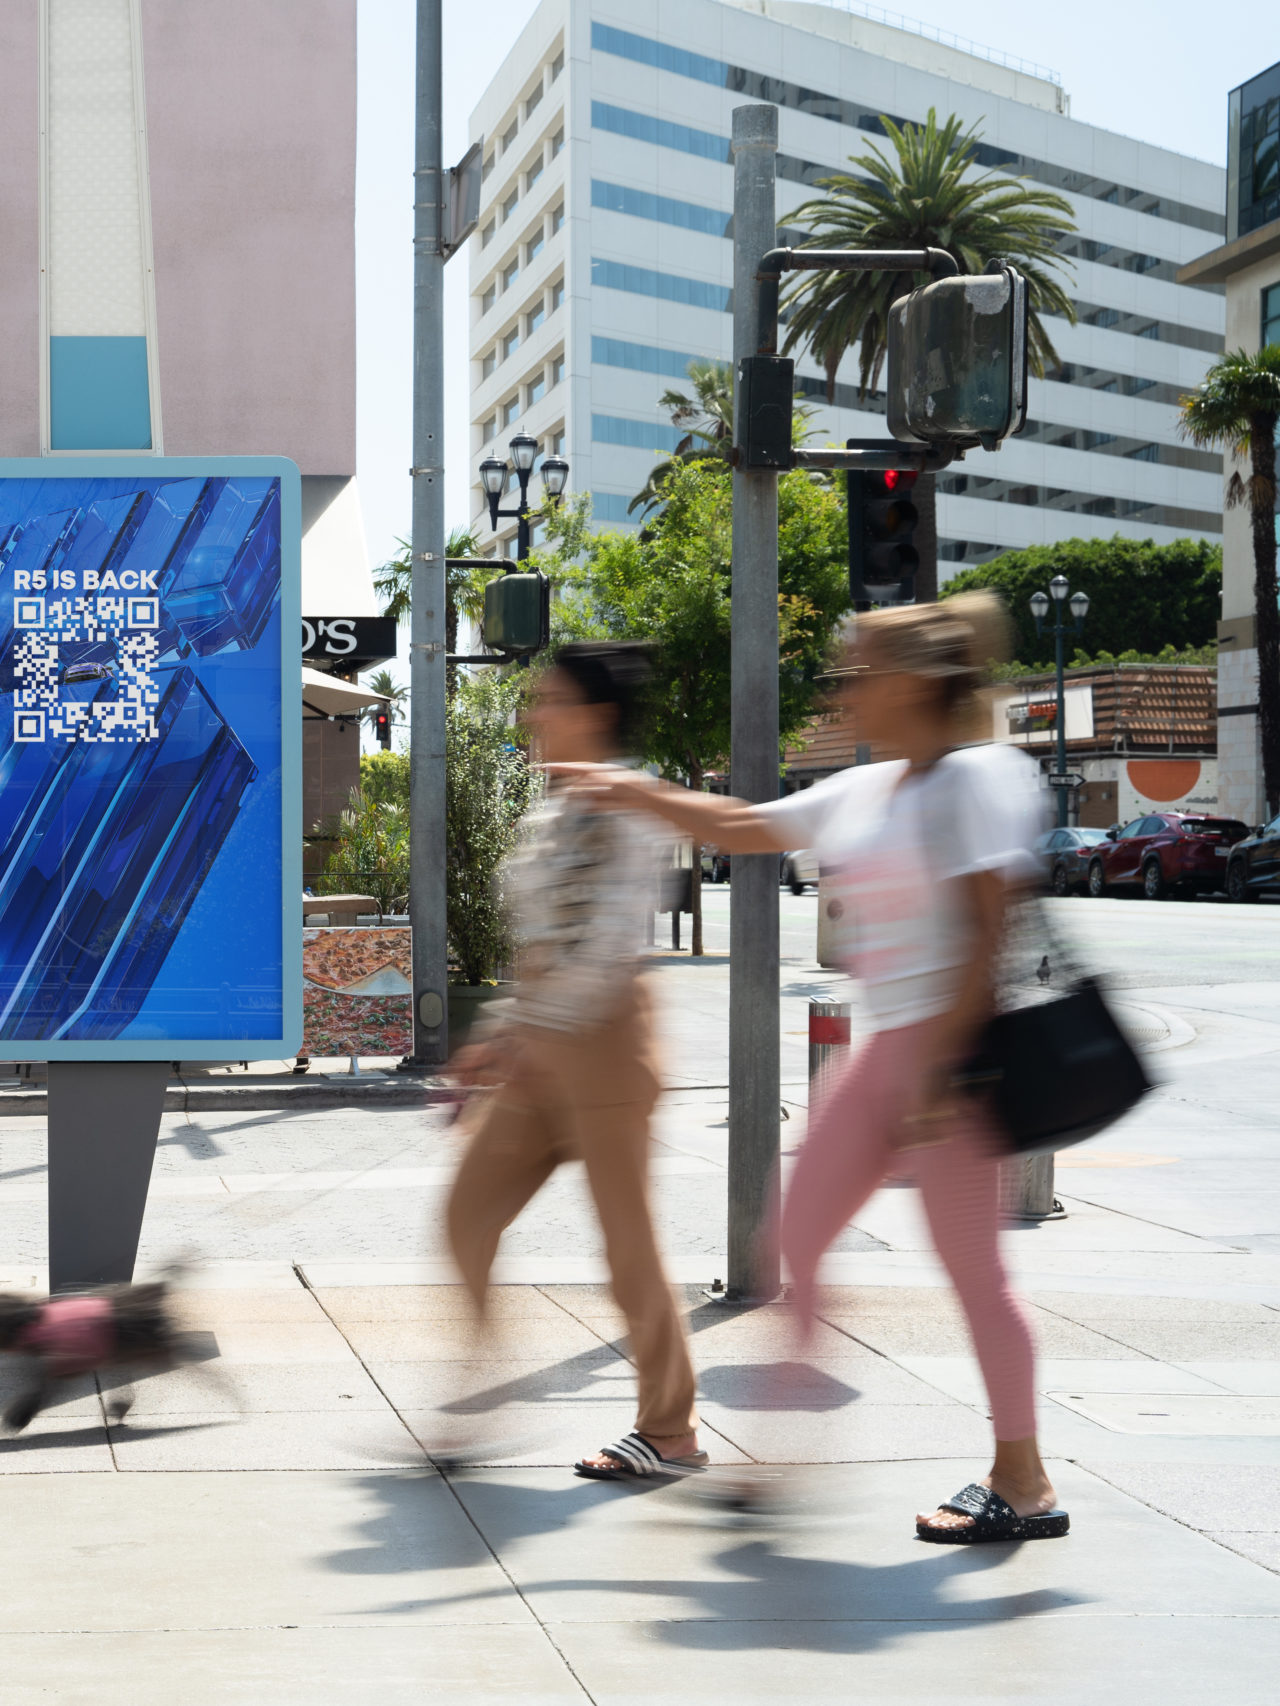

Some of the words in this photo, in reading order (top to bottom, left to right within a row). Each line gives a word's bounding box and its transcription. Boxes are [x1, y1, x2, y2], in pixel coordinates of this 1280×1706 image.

[14, 570, 47, 590] R5
[53, 570, 76, 590] IS
[83, 570, 159, 590] BACK
